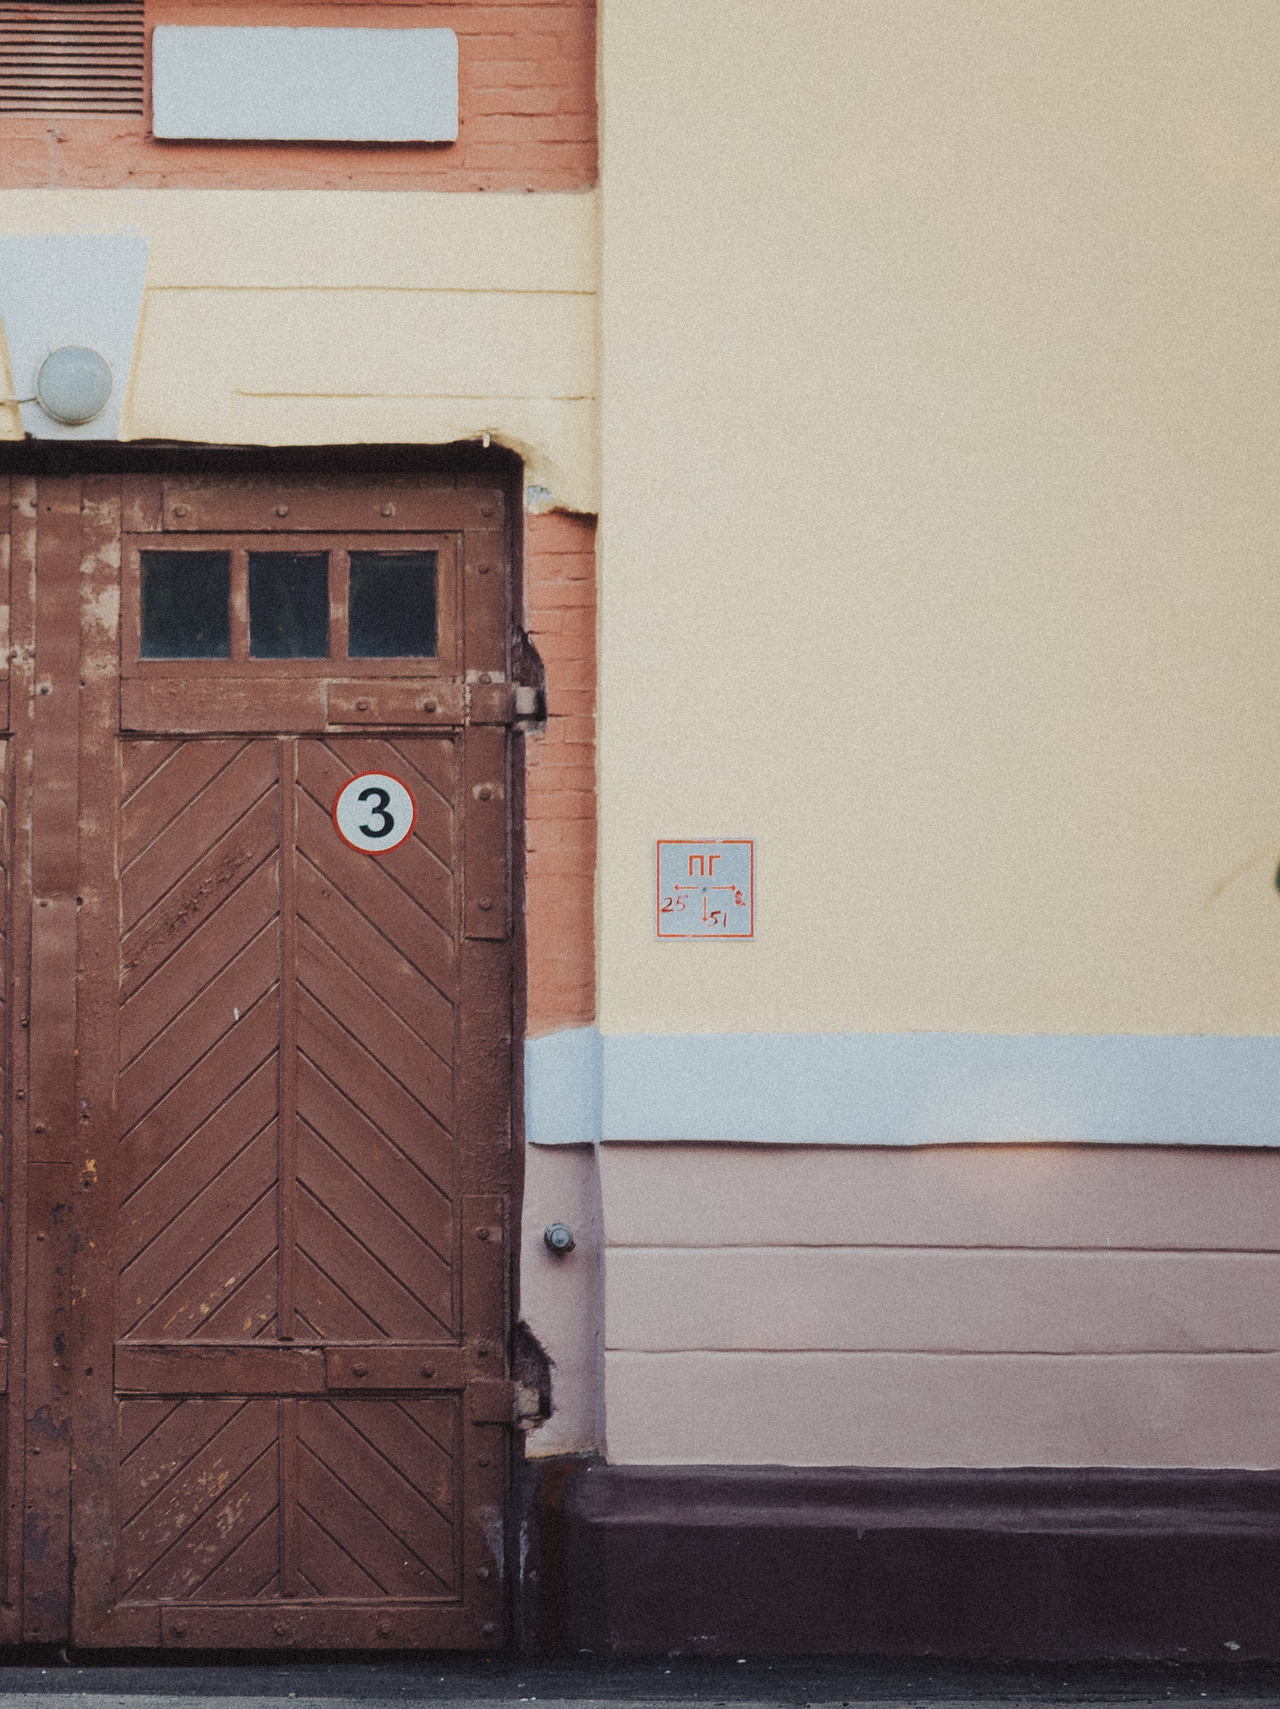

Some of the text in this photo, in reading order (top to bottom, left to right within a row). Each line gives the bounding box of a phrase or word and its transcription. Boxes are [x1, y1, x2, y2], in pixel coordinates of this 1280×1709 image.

[358, 787, 394, 839] 3
[688, 854, 721, 877] ПГ
[660, 894, 689, 913] 25
[706, 910, 728, 929] 51
